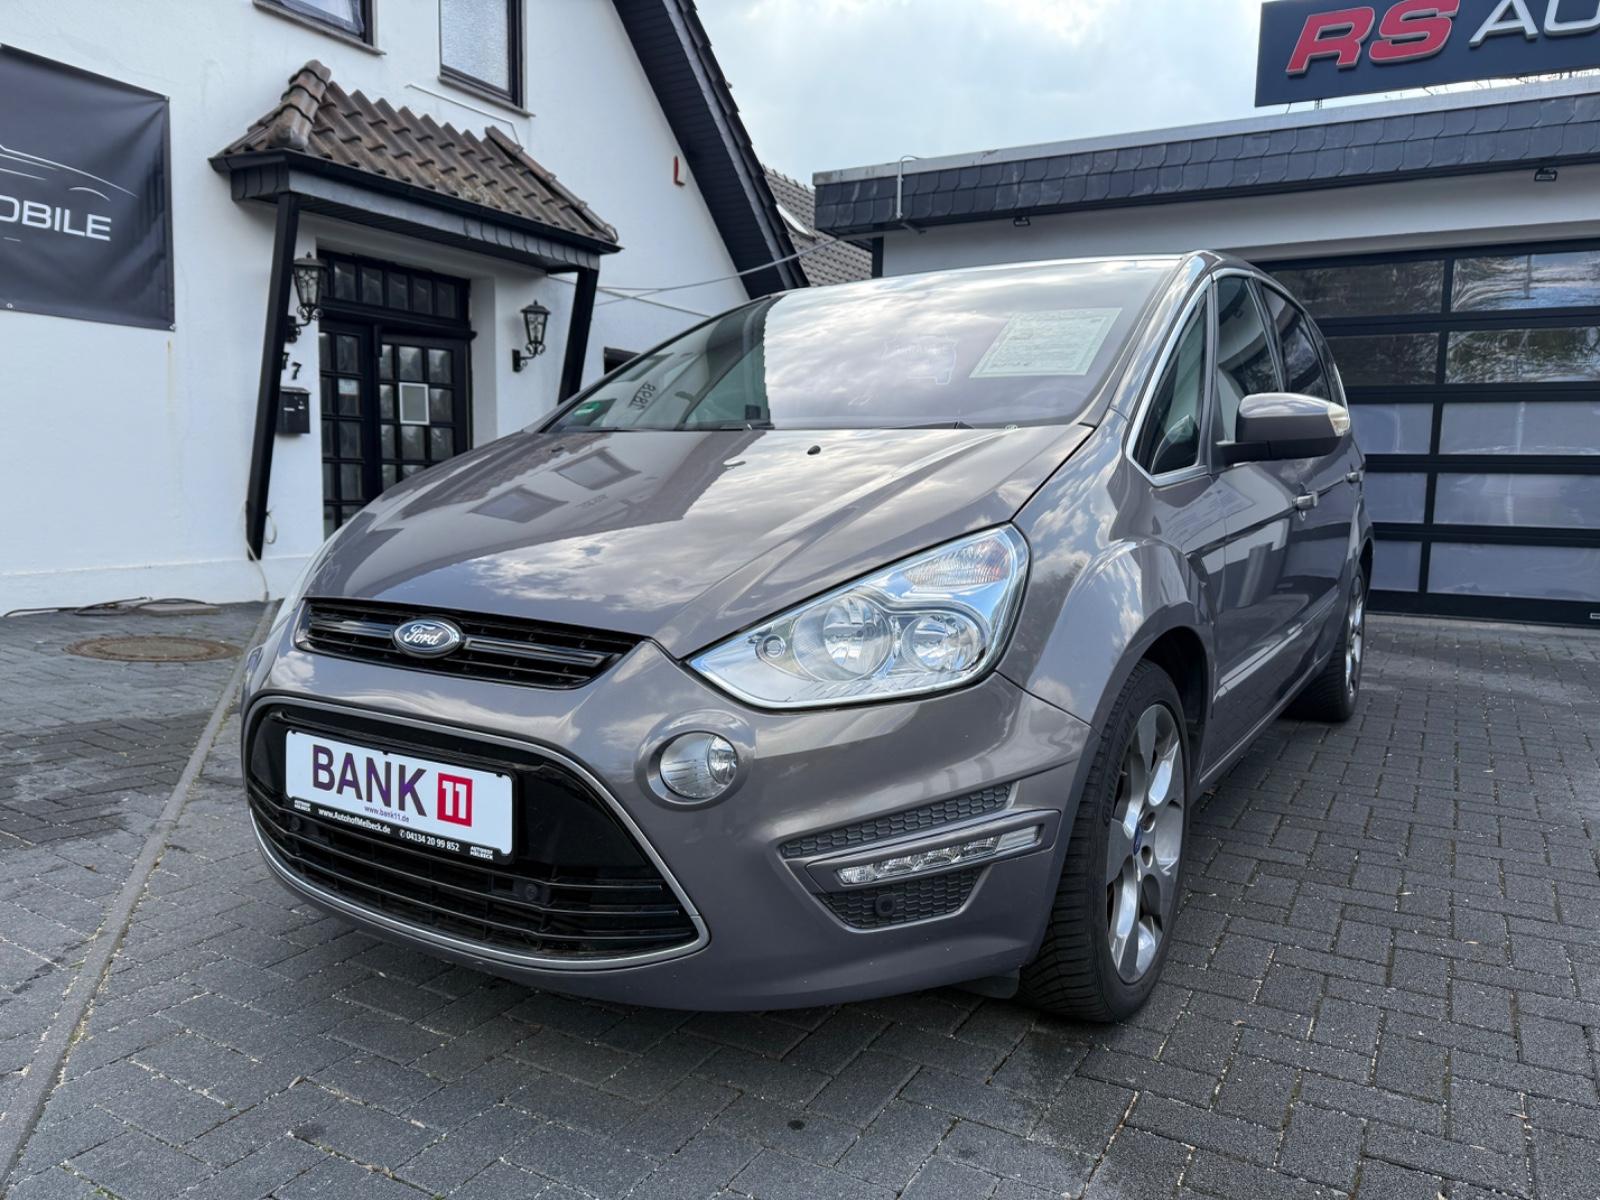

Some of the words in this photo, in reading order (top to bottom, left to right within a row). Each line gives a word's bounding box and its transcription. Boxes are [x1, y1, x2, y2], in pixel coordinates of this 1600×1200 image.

[1285, 0, 1462, 76] RS
[404, 624, 443, 645] Ford
[313, 744, 428, 817] BANK
[442, 780, 467, 820] 11
[318, 808, 391, 834] www.AutohofMelbeck.de
[364, 805, 410, 823] www.bank11.de
[406, 832, 425, 845] 04134
[426, 836, 436, 847] 20
[436, 838, 446, 849] 99
[446, 840, 460, 852] 852
